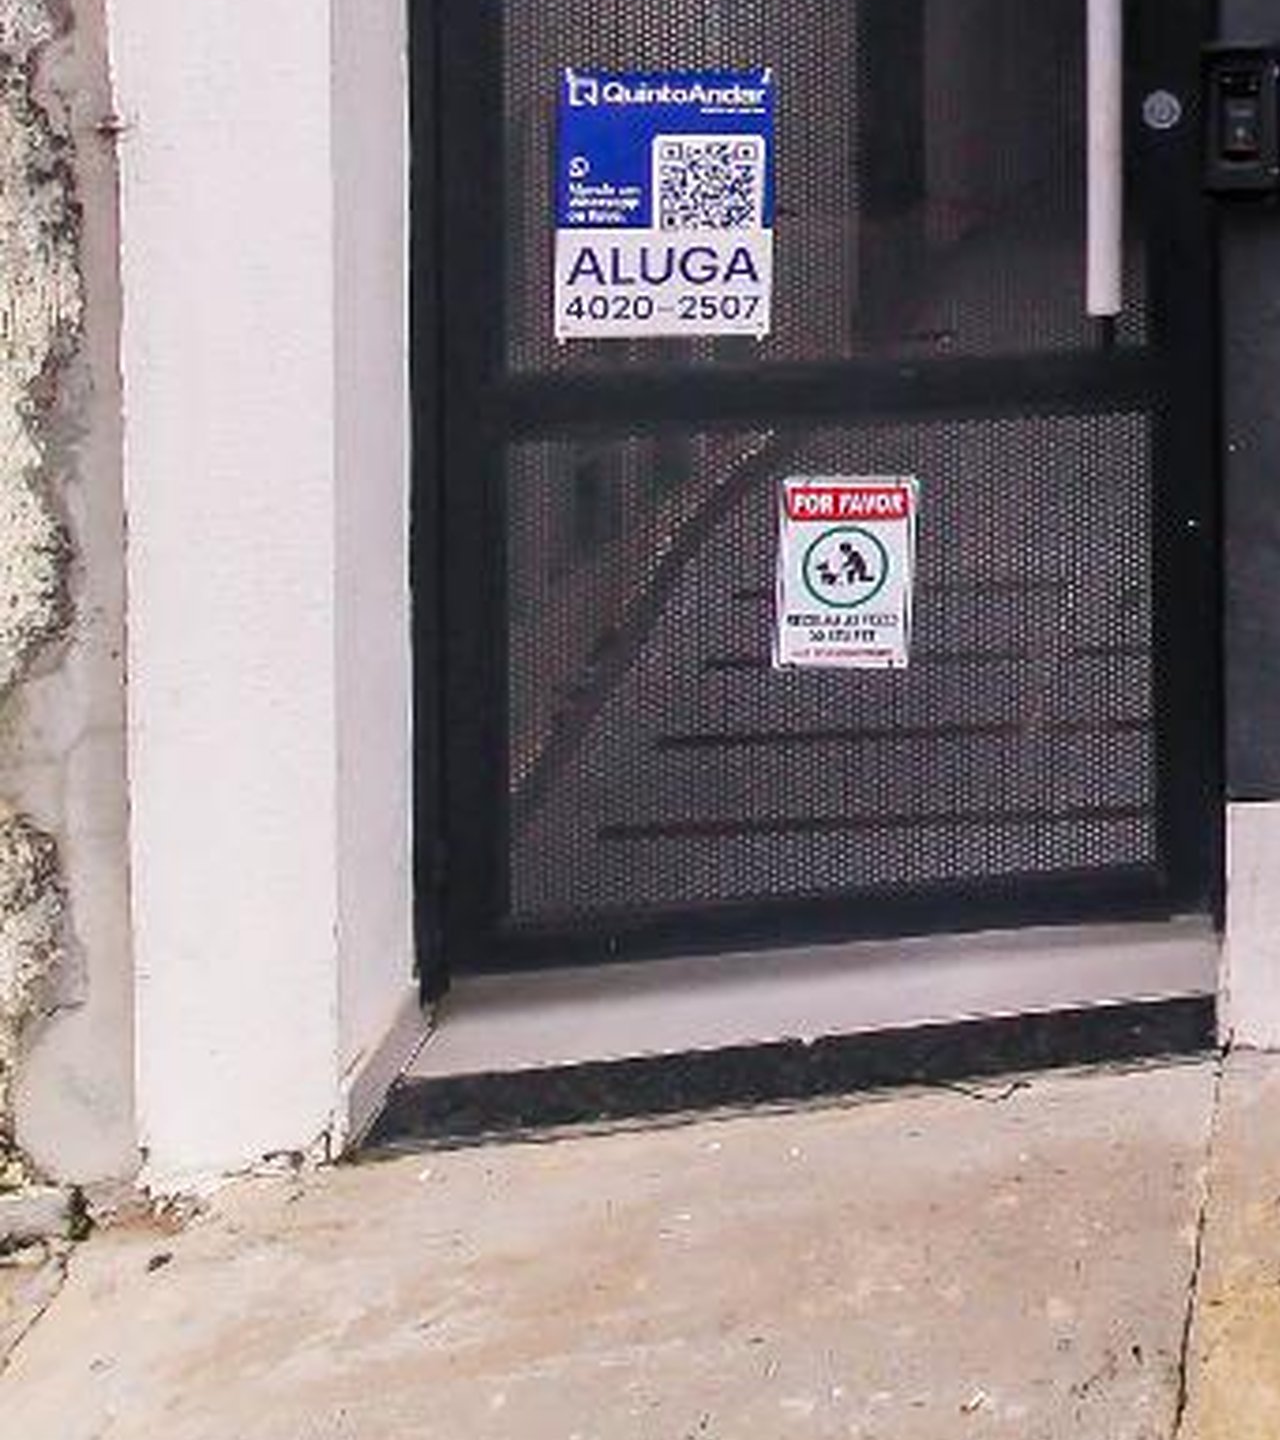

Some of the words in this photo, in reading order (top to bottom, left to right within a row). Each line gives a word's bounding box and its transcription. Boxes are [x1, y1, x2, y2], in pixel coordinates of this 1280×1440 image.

[602, 81, 766, 104] QuintoAndar
[566, 246, 760, 287] ALUGA
[565, 295, 762, 321] 4020-2507
